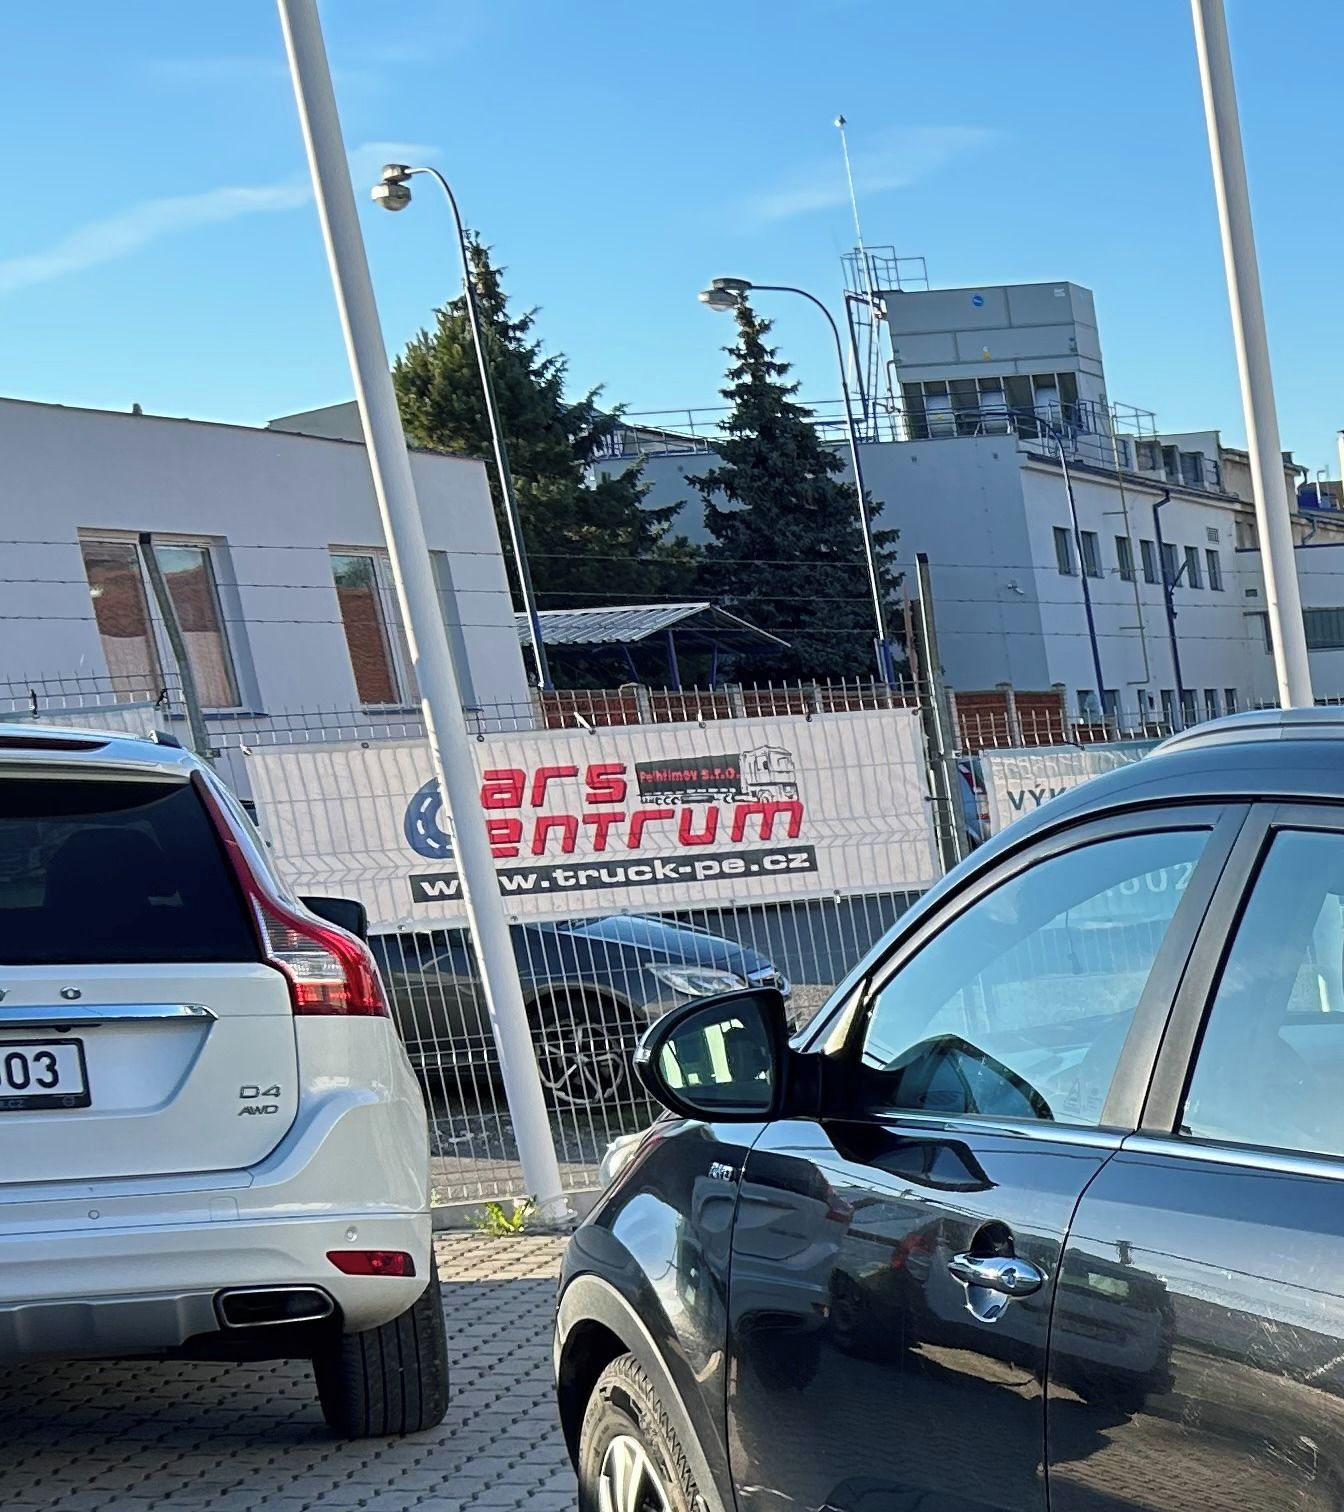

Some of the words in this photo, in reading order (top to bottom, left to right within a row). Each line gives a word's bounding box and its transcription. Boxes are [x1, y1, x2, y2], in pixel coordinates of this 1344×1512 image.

[420, 850, 811, 898] ww.truck-pe.cz
[0, 1050, 59, 1090] 03
[239, 1084, 281, 1099] D4
[238, 1104, 279, 1117] AWD
